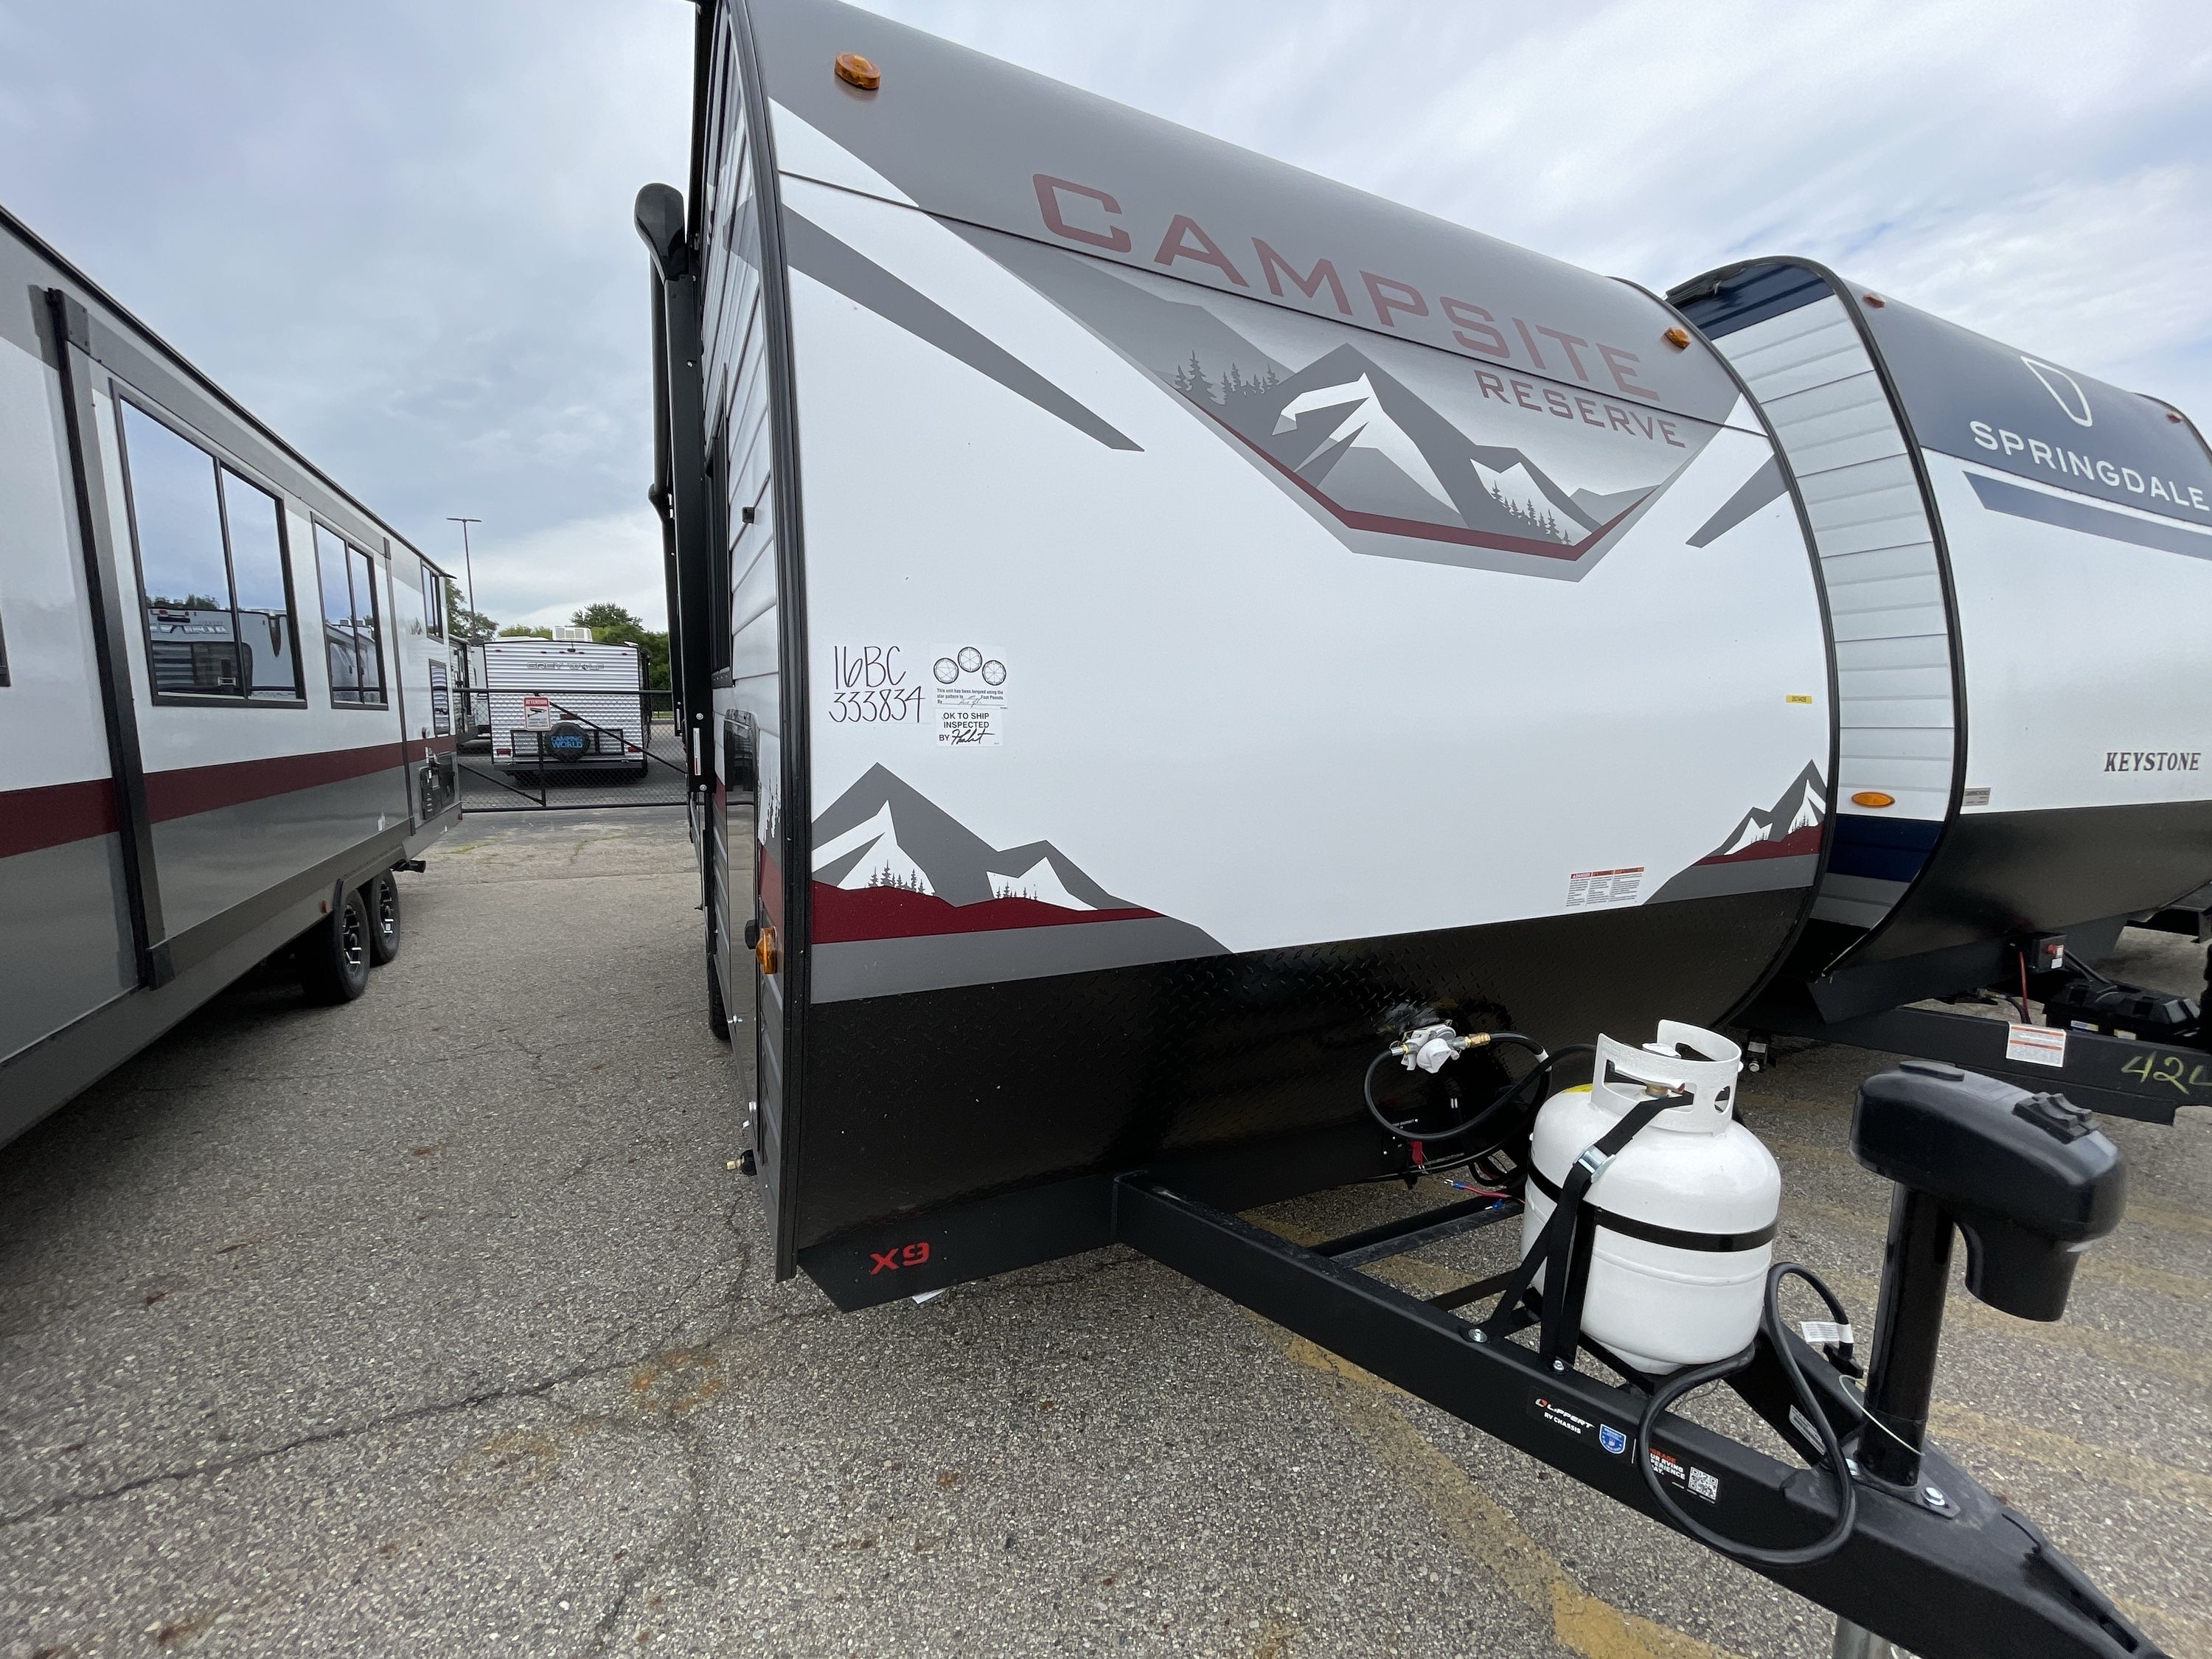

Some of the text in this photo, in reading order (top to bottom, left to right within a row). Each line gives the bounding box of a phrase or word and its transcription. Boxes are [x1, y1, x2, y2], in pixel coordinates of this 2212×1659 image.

[1032, 173, 1660, 402] CAMPSITE
[1473, 369, 1686, 448] RESERVE
[1969, 420, 2211, 511] SPRINGDALE
[833, 645, 906, 690] 16BC
[828, 685, 926, 723] 333834
[2104, 752, 2201, 772] KEYSTONE
[869, 1242, 930, 1275] X9
[1544, 1411, 1582, 1434] RV CHASSIS
[1650, 1458, 1686, 1481] PERIENCE
